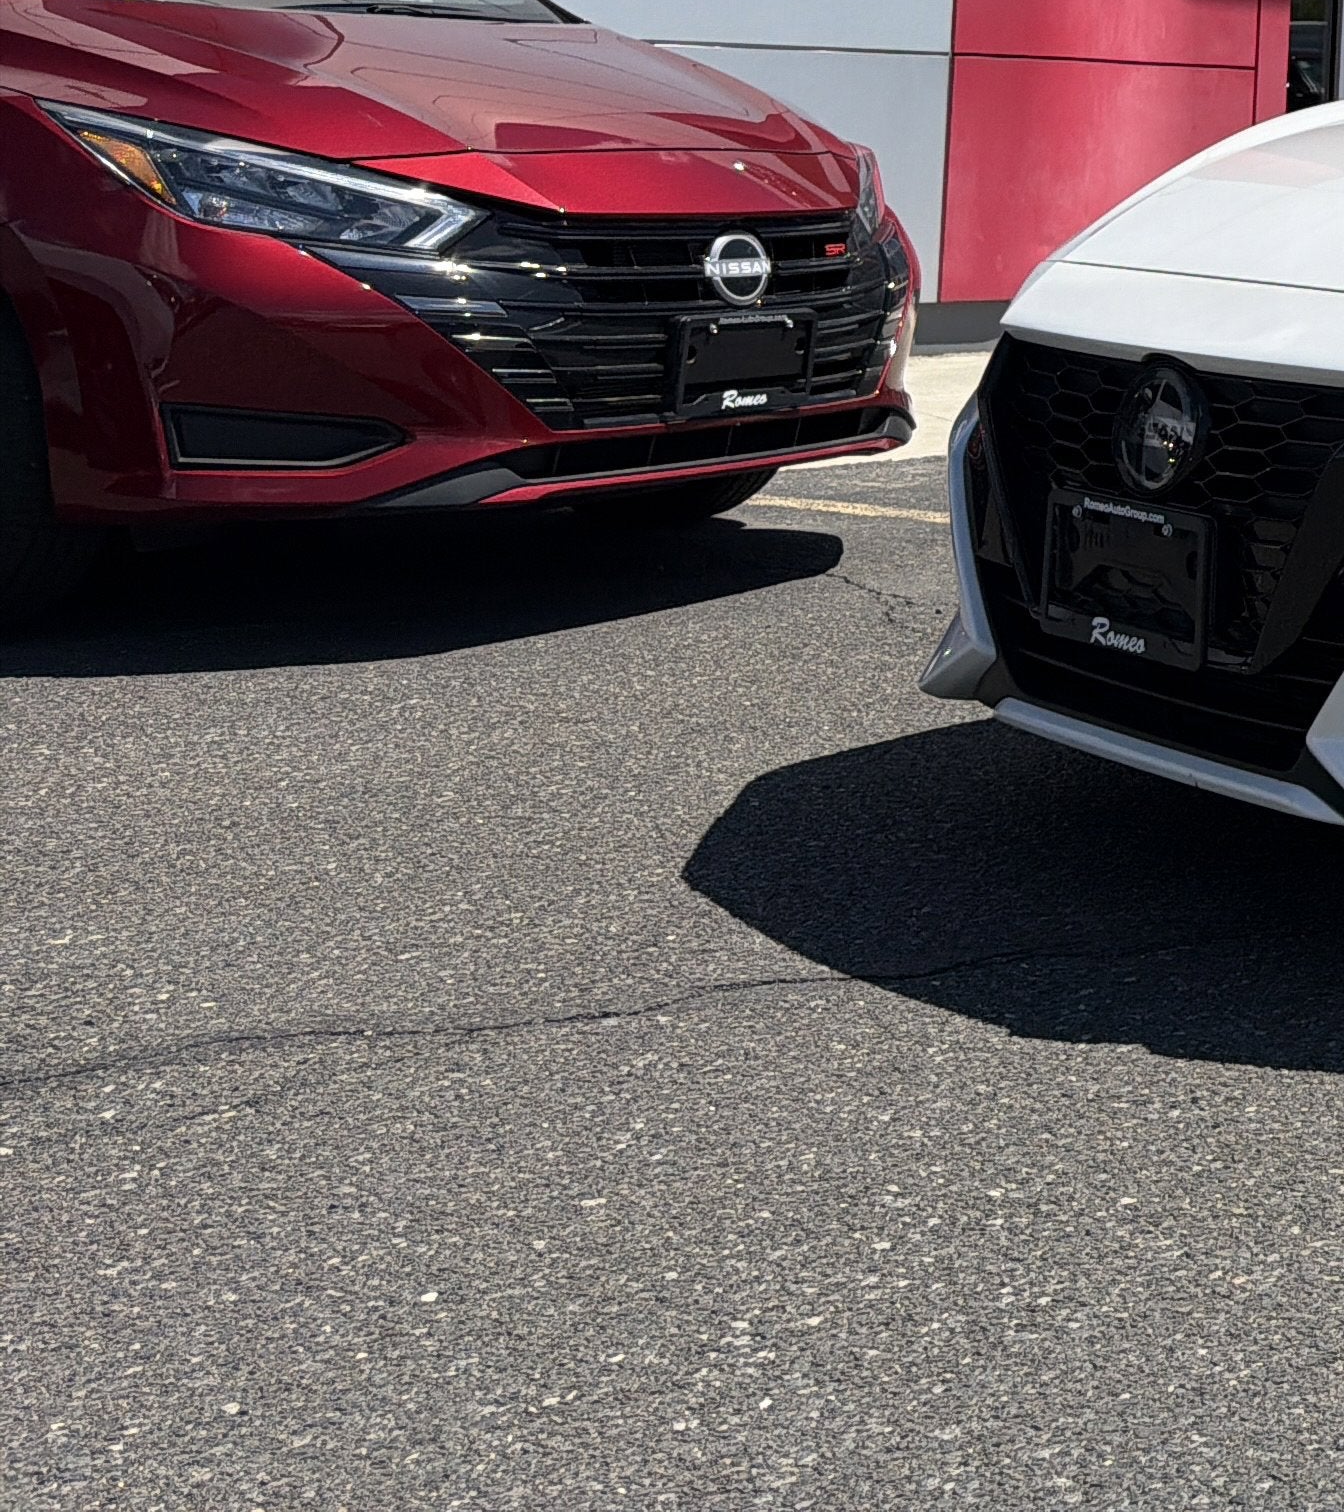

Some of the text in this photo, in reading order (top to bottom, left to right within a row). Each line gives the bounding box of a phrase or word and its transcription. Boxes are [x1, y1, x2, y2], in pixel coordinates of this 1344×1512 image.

[825, 243, 846, 256] SR
[705, 261, 770, 277] NISSAN
[721, 389, 768, 409] Romeo
[1083, 496, 1165, 525] RomeoAutoGroup.com
[1090, 616, 1146, 654] Romeo
